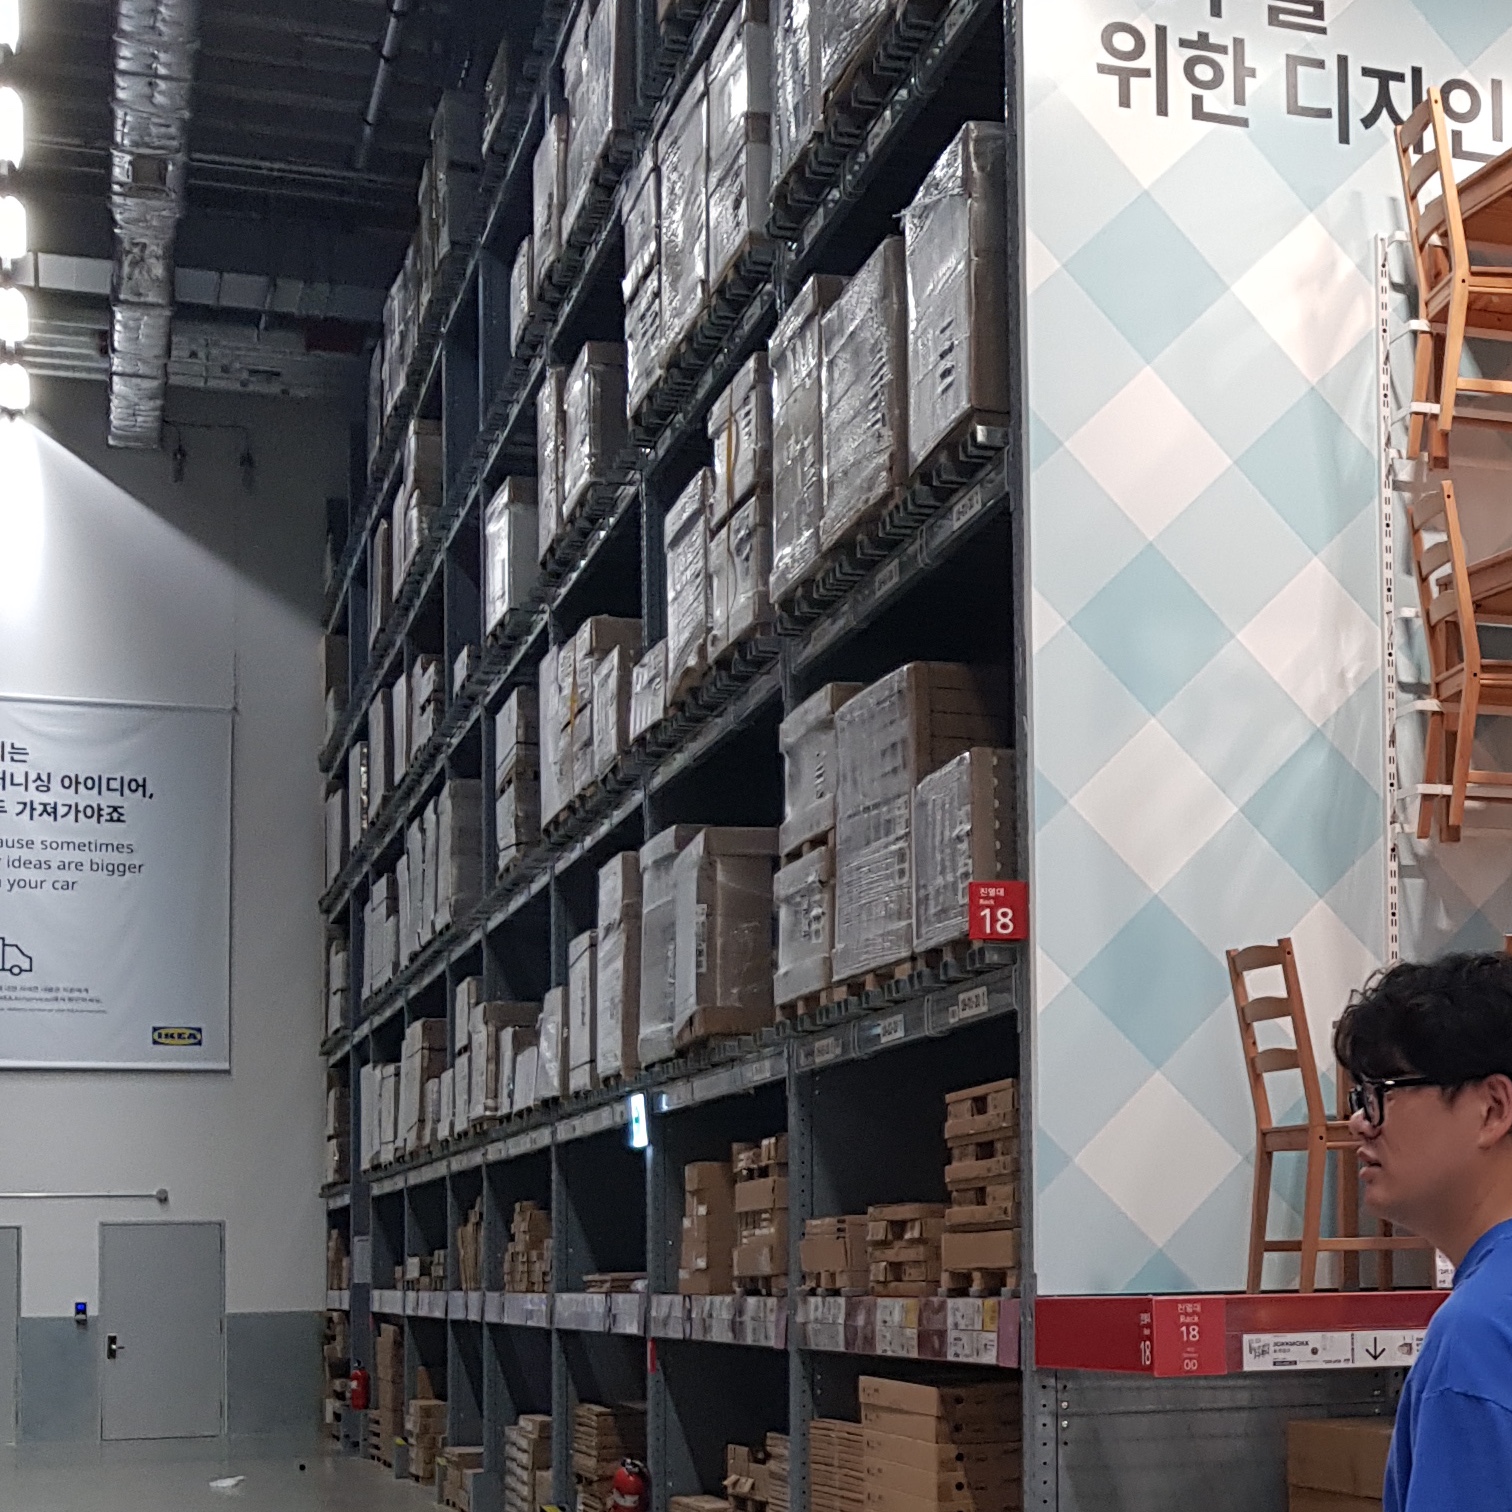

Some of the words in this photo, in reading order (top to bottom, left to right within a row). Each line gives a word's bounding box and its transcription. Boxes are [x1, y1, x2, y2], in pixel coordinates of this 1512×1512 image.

[1096, 21, 1257, 128] 위한
[1285, 53, 1503, 164] 디자인
[0, 741, 29, 763] 는
[60, 773, 154, 800] 아이디어,
[15, 799, 127, 824] 가져가야죠
[40, 838, 134, 854] sometimes
[6, 854, 52, 870] ideas
[56, 860, 84, 872] are
[89, 858, 145, 877] bigger
[6, 877, 47, 893] your
[51, 879, 79, 891] car
[980, 887, 1005, 897] 진열대
[980, 907, 1014, 935] 18
[1179, 1314, 1199, 1323] Rack
[1179, 1325, 1200, 1342] 18
[1139, 1340, 1151, 1366] 18
[1183, 1359, 1199, 1370] 00
